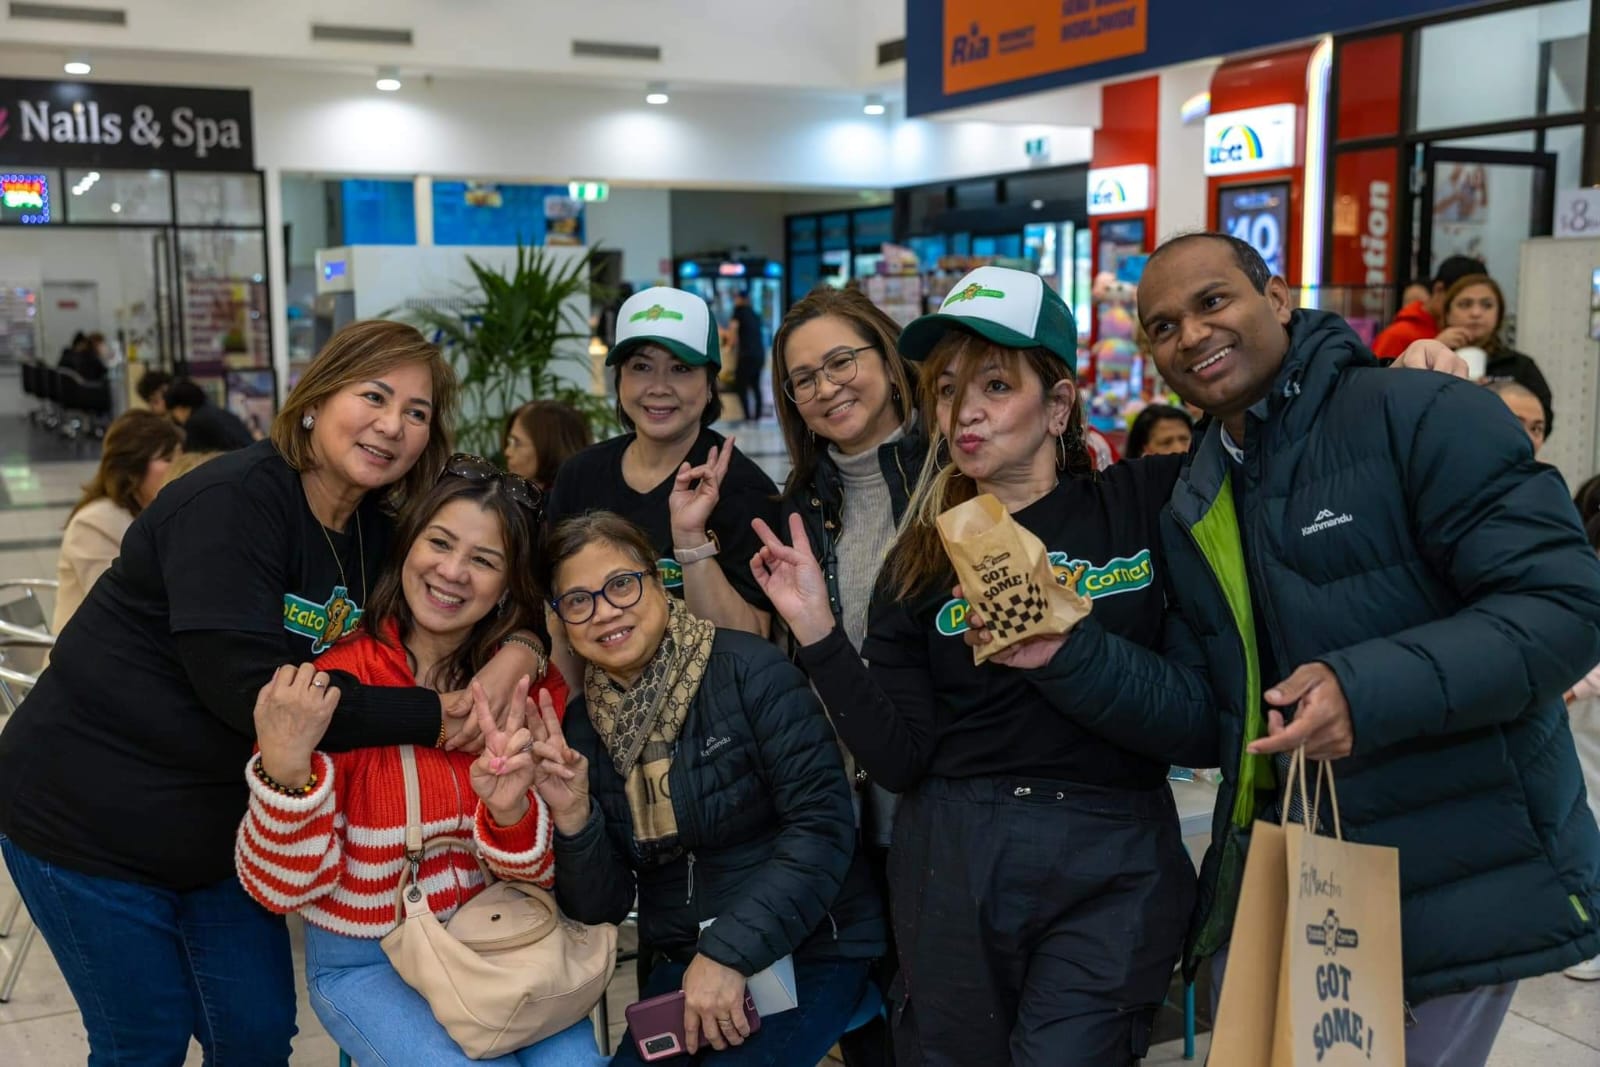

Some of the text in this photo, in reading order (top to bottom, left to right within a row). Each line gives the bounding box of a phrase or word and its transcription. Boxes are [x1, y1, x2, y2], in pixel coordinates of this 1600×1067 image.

[951, 22, 990, 66] Ria
[18, 100, 122, 144] Nails
[129, 104, 164, 149] &
[171, 106, 241, 158] Spa
[1301, 512, 1353, 537] Kathmandu
[982, 565, 1009, 585] GOT
[1316, 961, 1352, 1002] GOT
